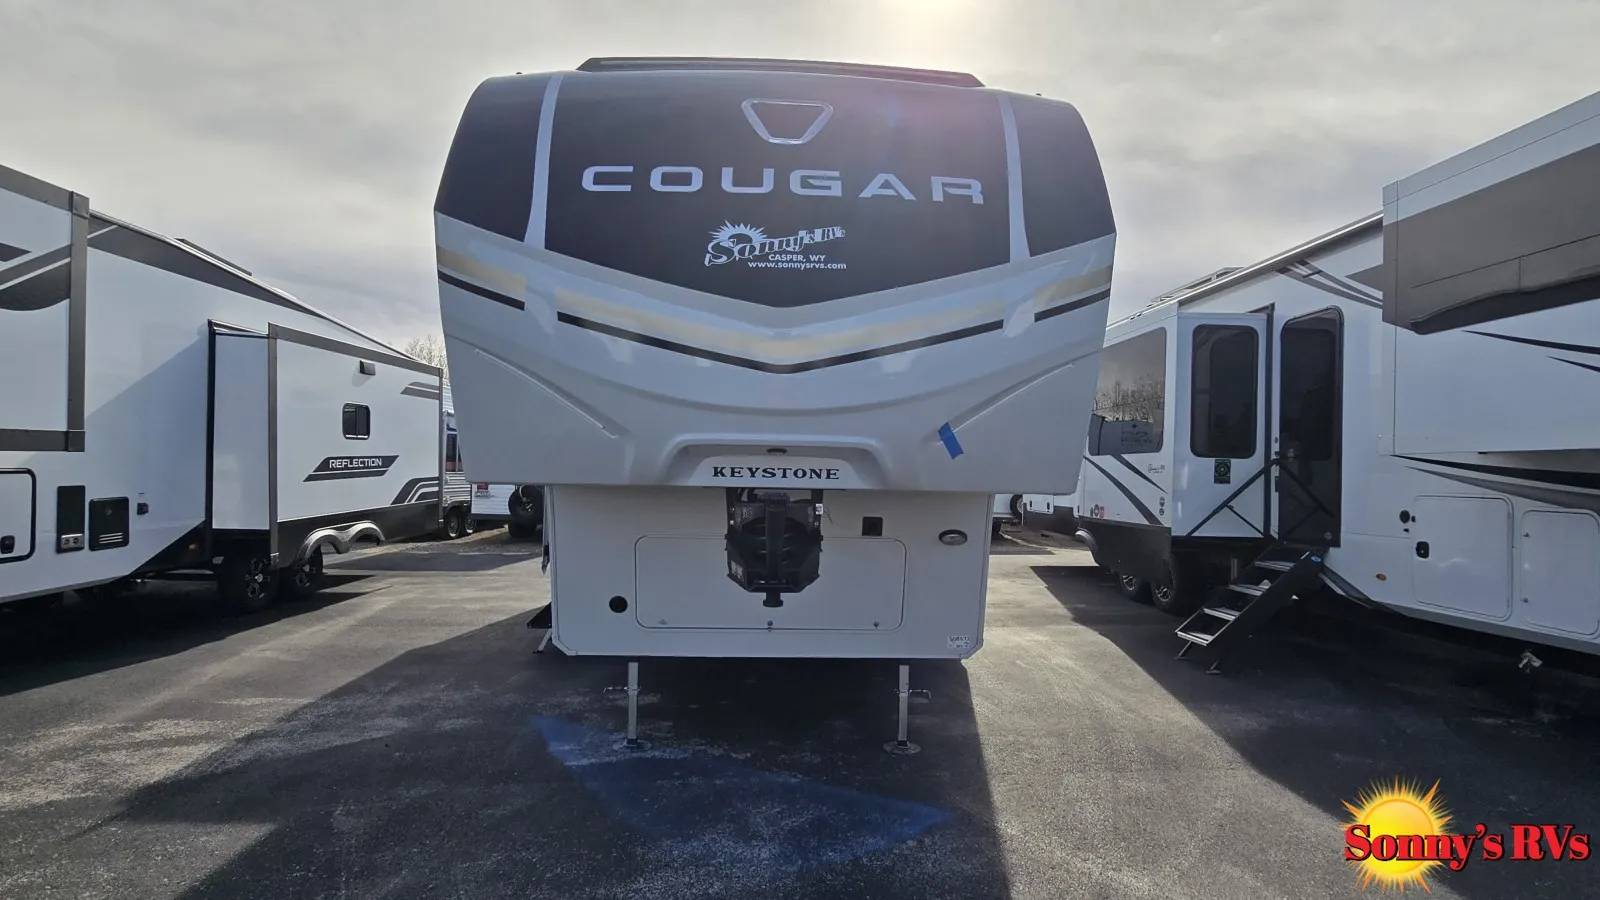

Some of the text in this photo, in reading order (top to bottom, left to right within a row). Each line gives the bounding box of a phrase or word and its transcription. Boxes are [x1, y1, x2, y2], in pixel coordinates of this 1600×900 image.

[581, 165, 984, 205] COUGAR
[704, 226, 846, 266] Sonny's RVs
[768, 254, 826, 263] CASPER, WY
[748, 261, 847, 271] www.sonnysrvs.com
[329, 458, 382, 468] REFLECTION
[712, 466, 840, 480] KEYSTONE
